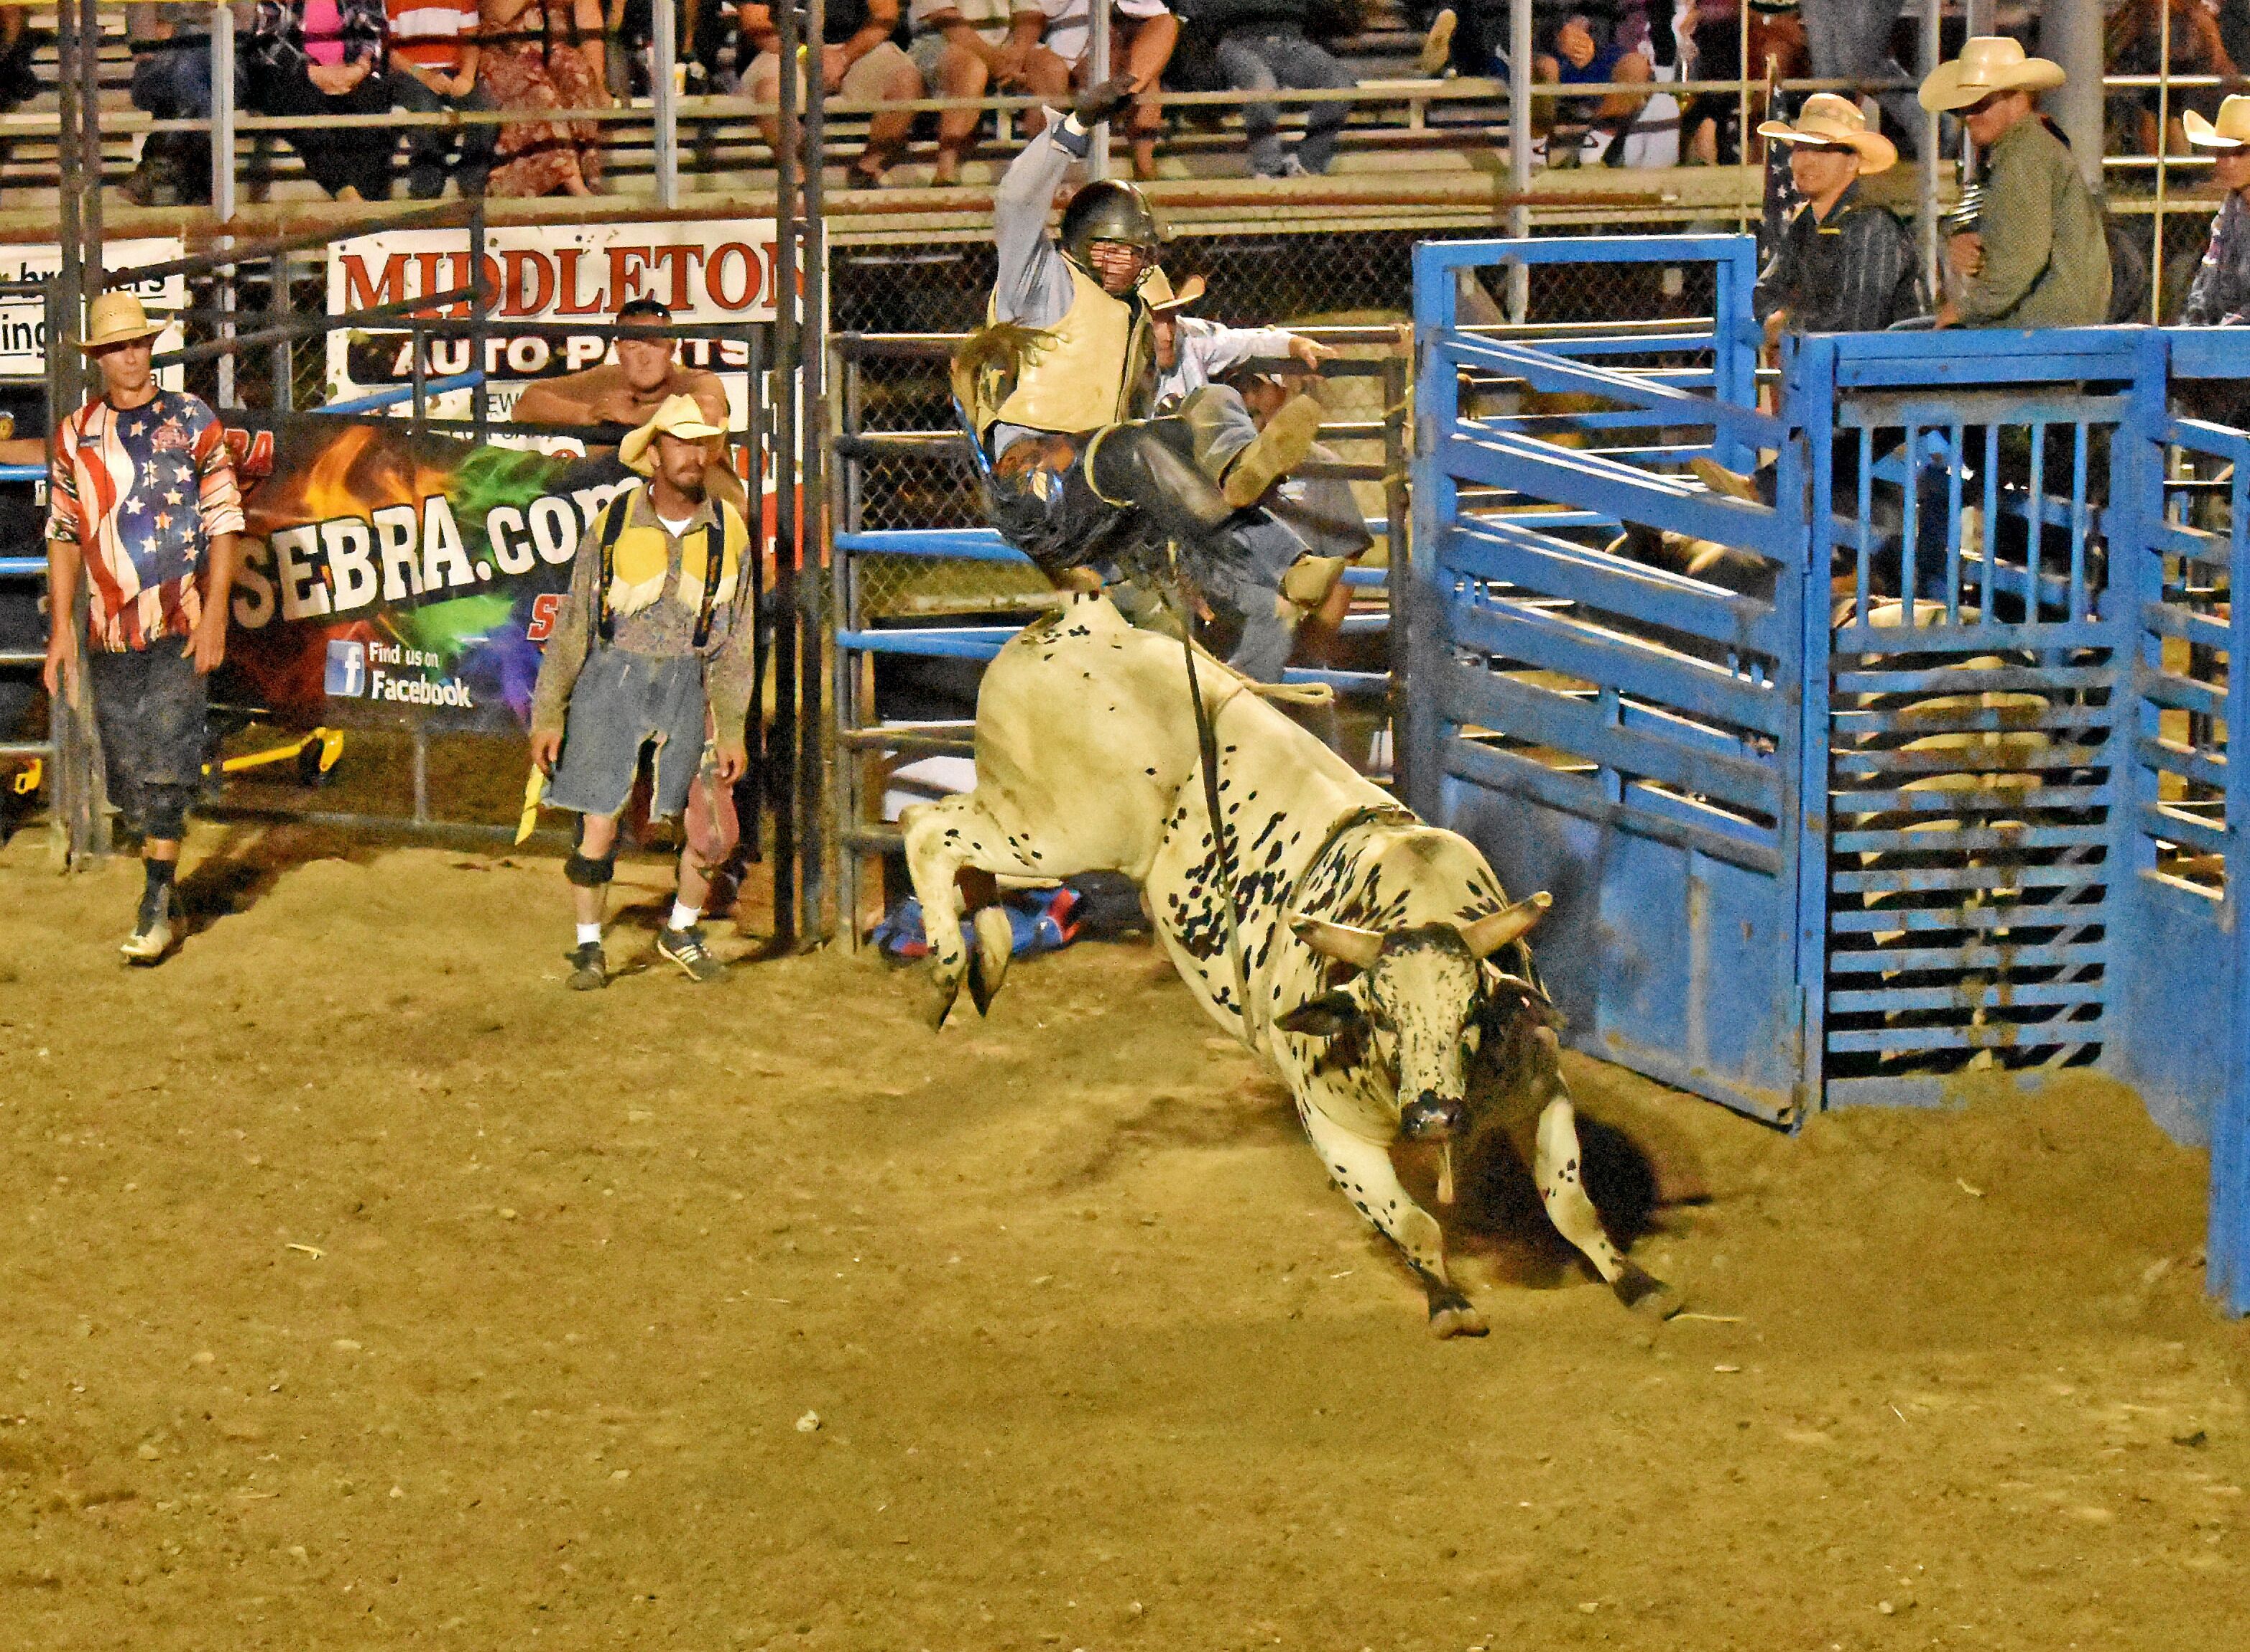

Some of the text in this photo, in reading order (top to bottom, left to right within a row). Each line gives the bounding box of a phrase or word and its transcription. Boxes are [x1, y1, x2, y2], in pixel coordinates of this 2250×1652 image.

[338, 241, 805, 320] MIDDLETO
[392, 335, 550, 376] AUTO
[369, 641, 439, 669] Find us on
[371, 669, 473, 708] Facebook
